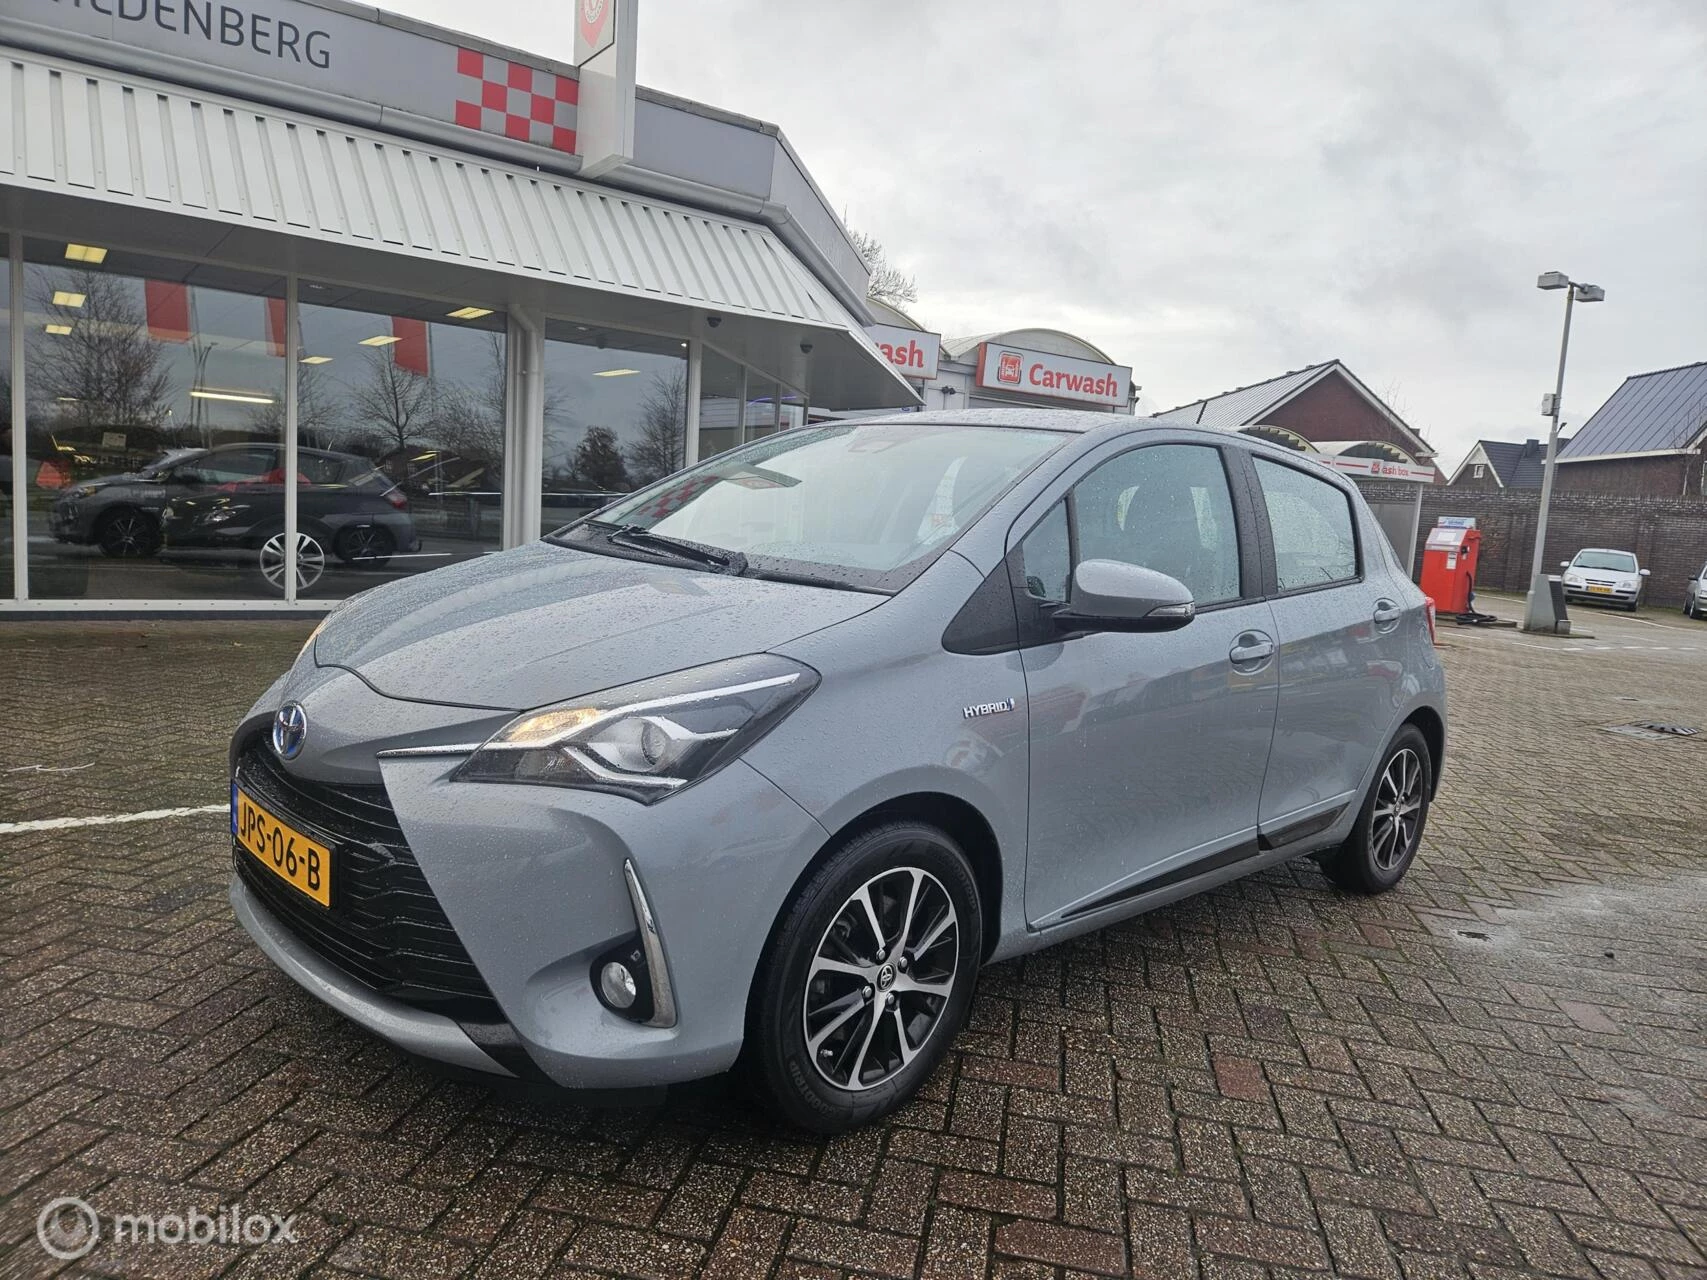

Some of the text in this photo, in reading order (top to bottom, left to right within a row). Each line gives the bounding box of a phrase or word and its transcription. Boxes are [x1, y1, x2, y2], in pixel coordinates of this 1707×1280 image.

[875, 340, 924, 368] ash
[1029, 363, 1118, 397] Carwash
[963, 701, 1010, 718] HYBRID
[241, 802, 321, 891] JPS-06-B
